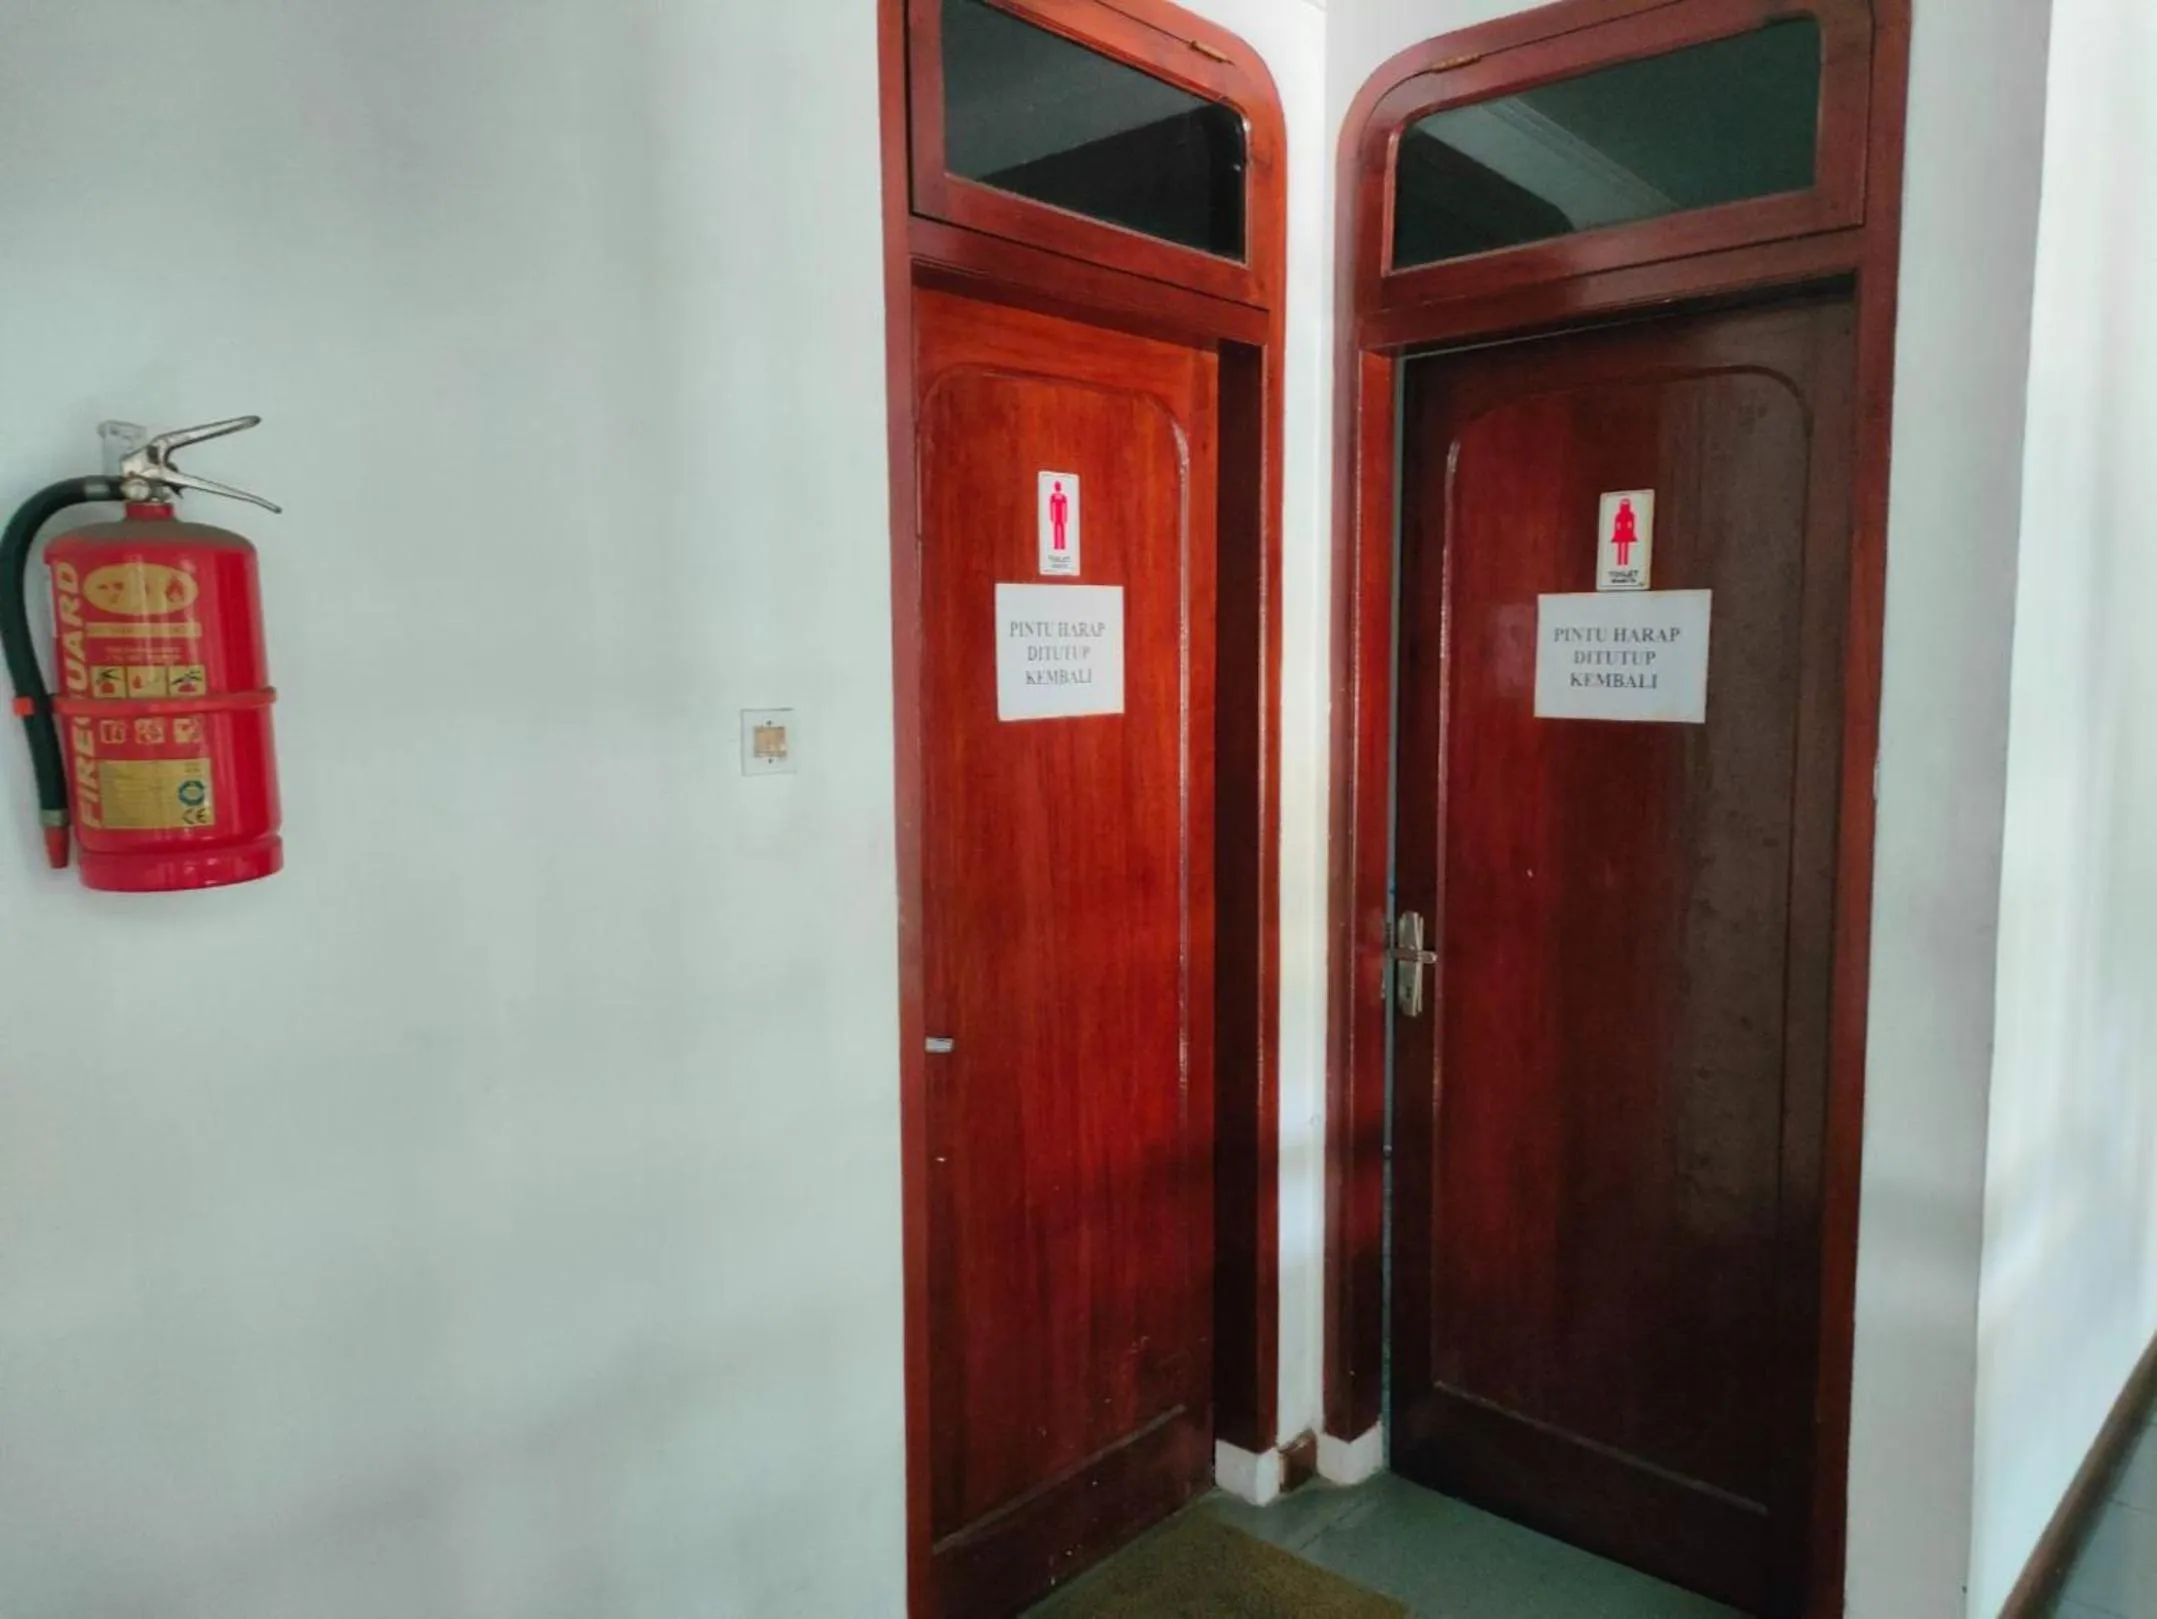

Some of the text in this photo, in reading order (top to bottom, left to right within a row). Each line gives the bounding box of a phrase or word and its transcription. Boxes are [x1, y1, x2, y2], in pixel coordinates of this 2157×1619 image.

[1009, 620, 1106, 638] PINTU HARAP
[1553, 627, 1681, 643] PINTU HARAP
[1027, 645, 1092, 662] DITUTUP
[1573, 650, 1657, 666] DITUTUP
[1025, 668, 1093, 686] KEMBALI
[1570, 672, 1658, 689] KEMBALI
